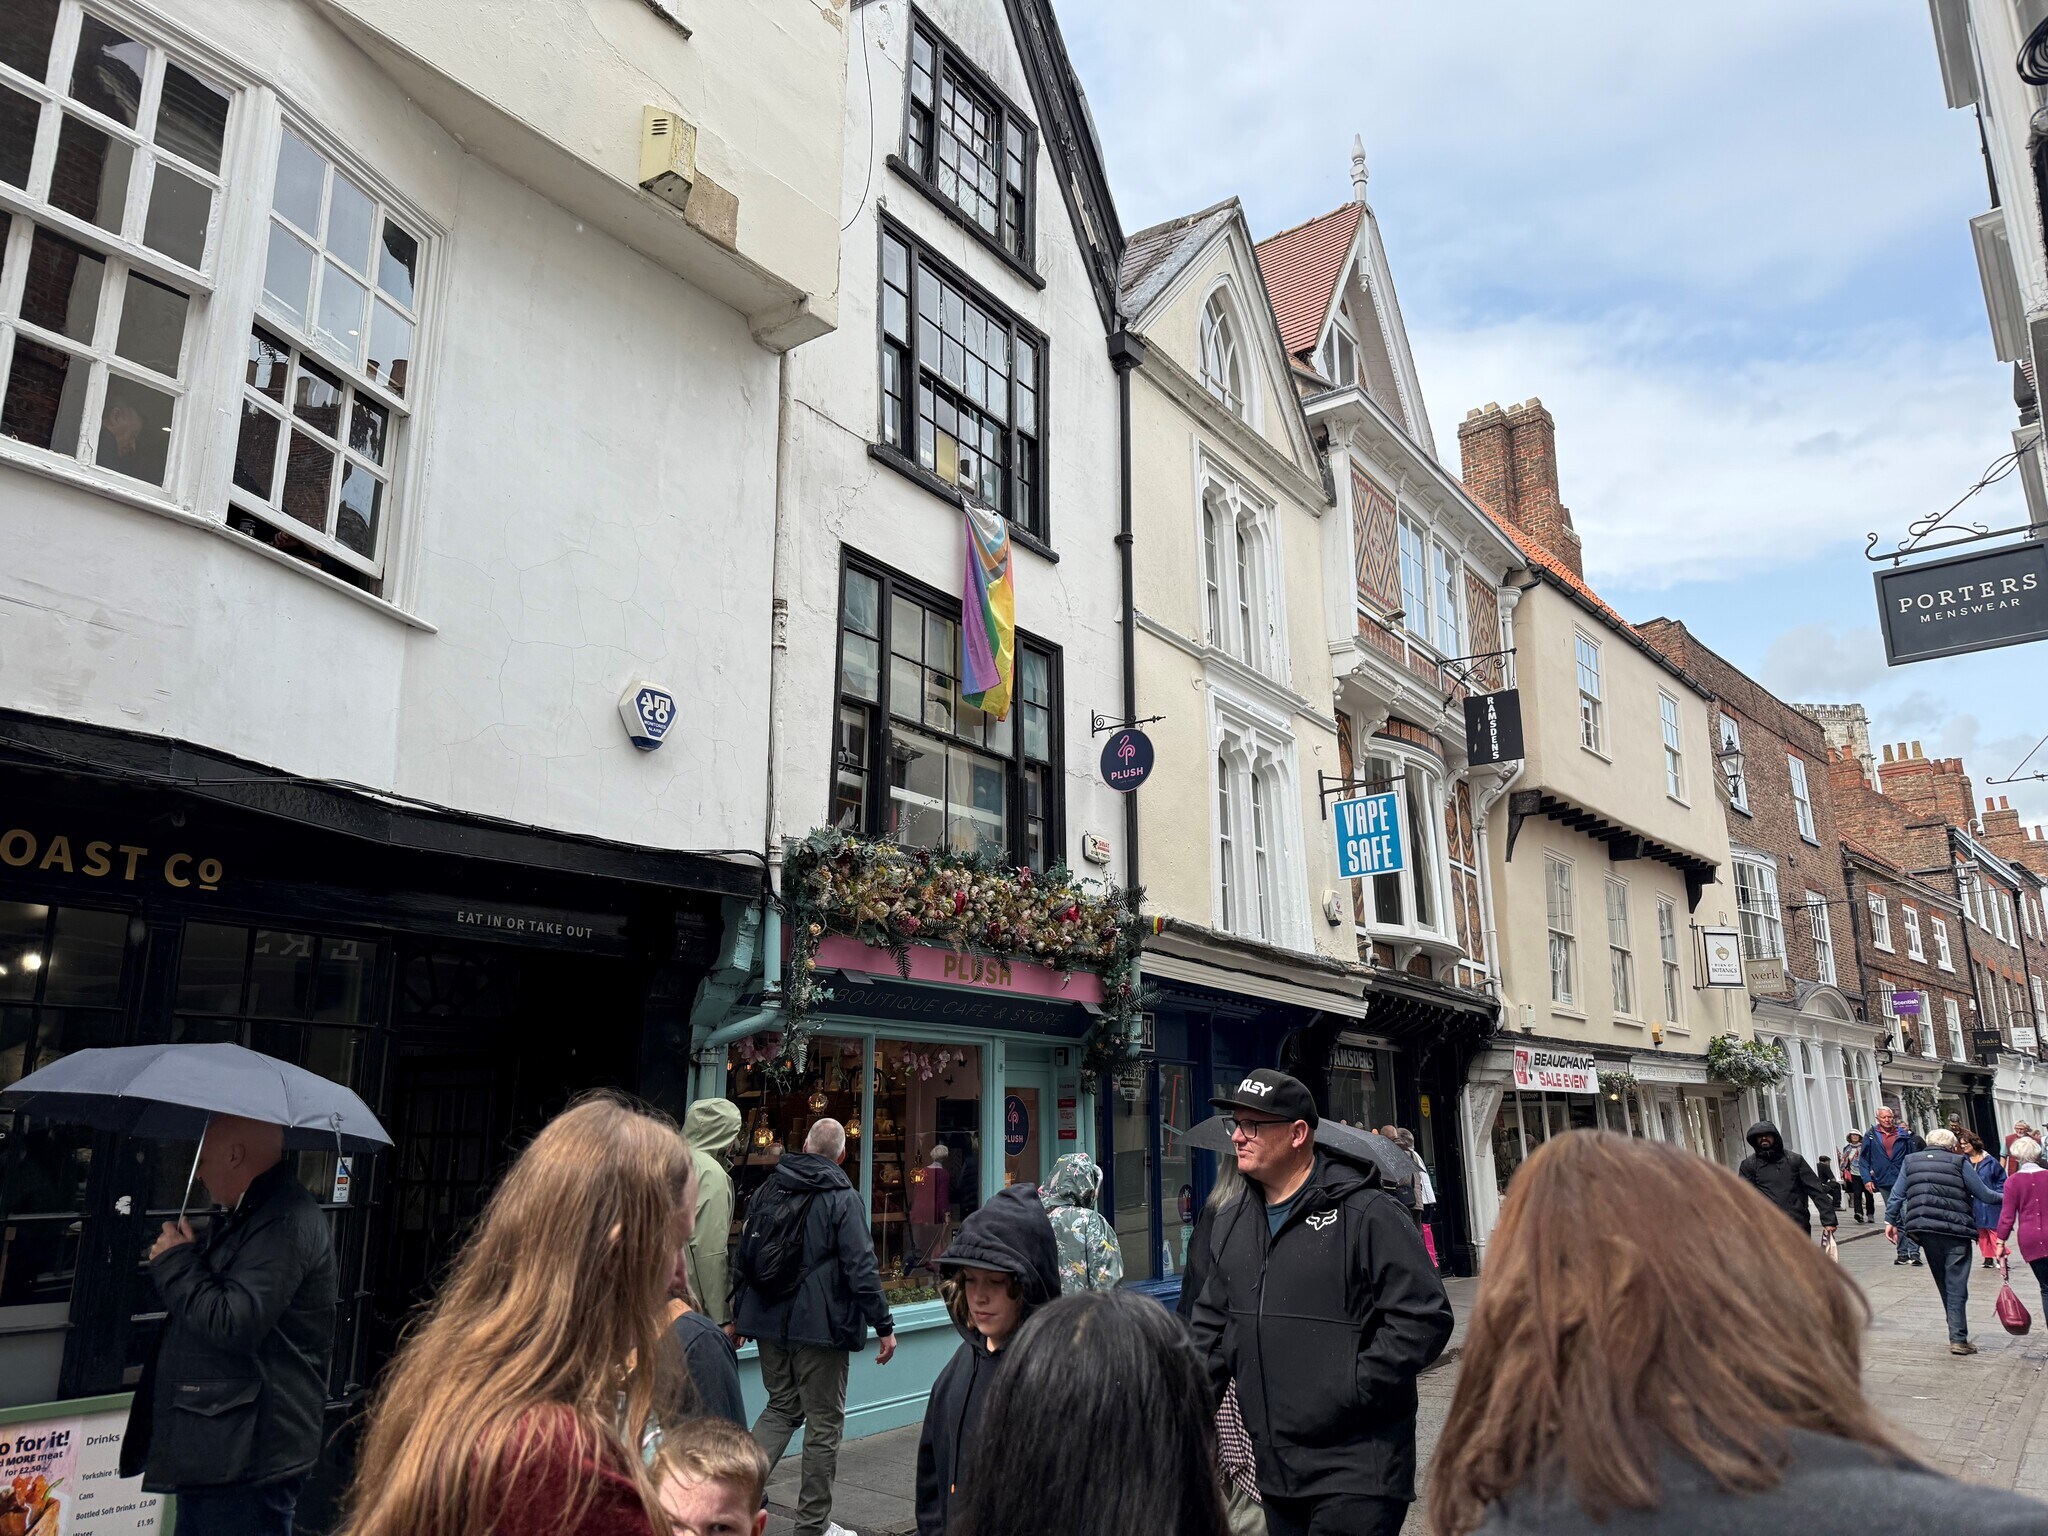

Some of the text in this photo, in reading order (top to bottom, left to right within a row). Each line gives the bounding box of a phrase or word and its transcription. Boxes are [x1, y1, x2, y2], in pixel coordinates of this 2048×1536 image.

[1898, 573, 2038, 613] PORTERS
[1920, 598, 2020, 623] MENSWEAR
[1487, 696, 1500, 760] RAMSDENS
[1111, 767, 1144, 781] PLUSH
[1343, 798, 1390, 837] VAPE
[0, 829, 148, 881] OAST
[1346, 834, 1393, 873] SAFE
[457, 911, 593, 939] EAT IN OR TAKE OUT
[943, 954, 1012, 987] PLUSH
[1751, 970, 1779, 980] werk
[835, 987, 940, 1013] BOUTIQUE
[993, 1007, 1009, 1020] &
[1010, 1008, 1065, 1026] STORE
[1539, 1071, 1562, 1088] SALE
[15, 1436, 46, 1454] for
[49, 1430, 71, 1449] it!
[86, 1433, 121, 1446] Drinks
[6, 1453, 36, 1467] MORE
[38, 1451, 64, 1462] meat
[5, 1465, 41, 1477] for £2.50
[82, 1469, 112, 1481] Yorkshire
[79, 1492, 94, 1501] Cans
[76, 1499, 157, 1521] Bottled Soft Drinks £3.00
[137, 1517, 154, 1528] £1.95
